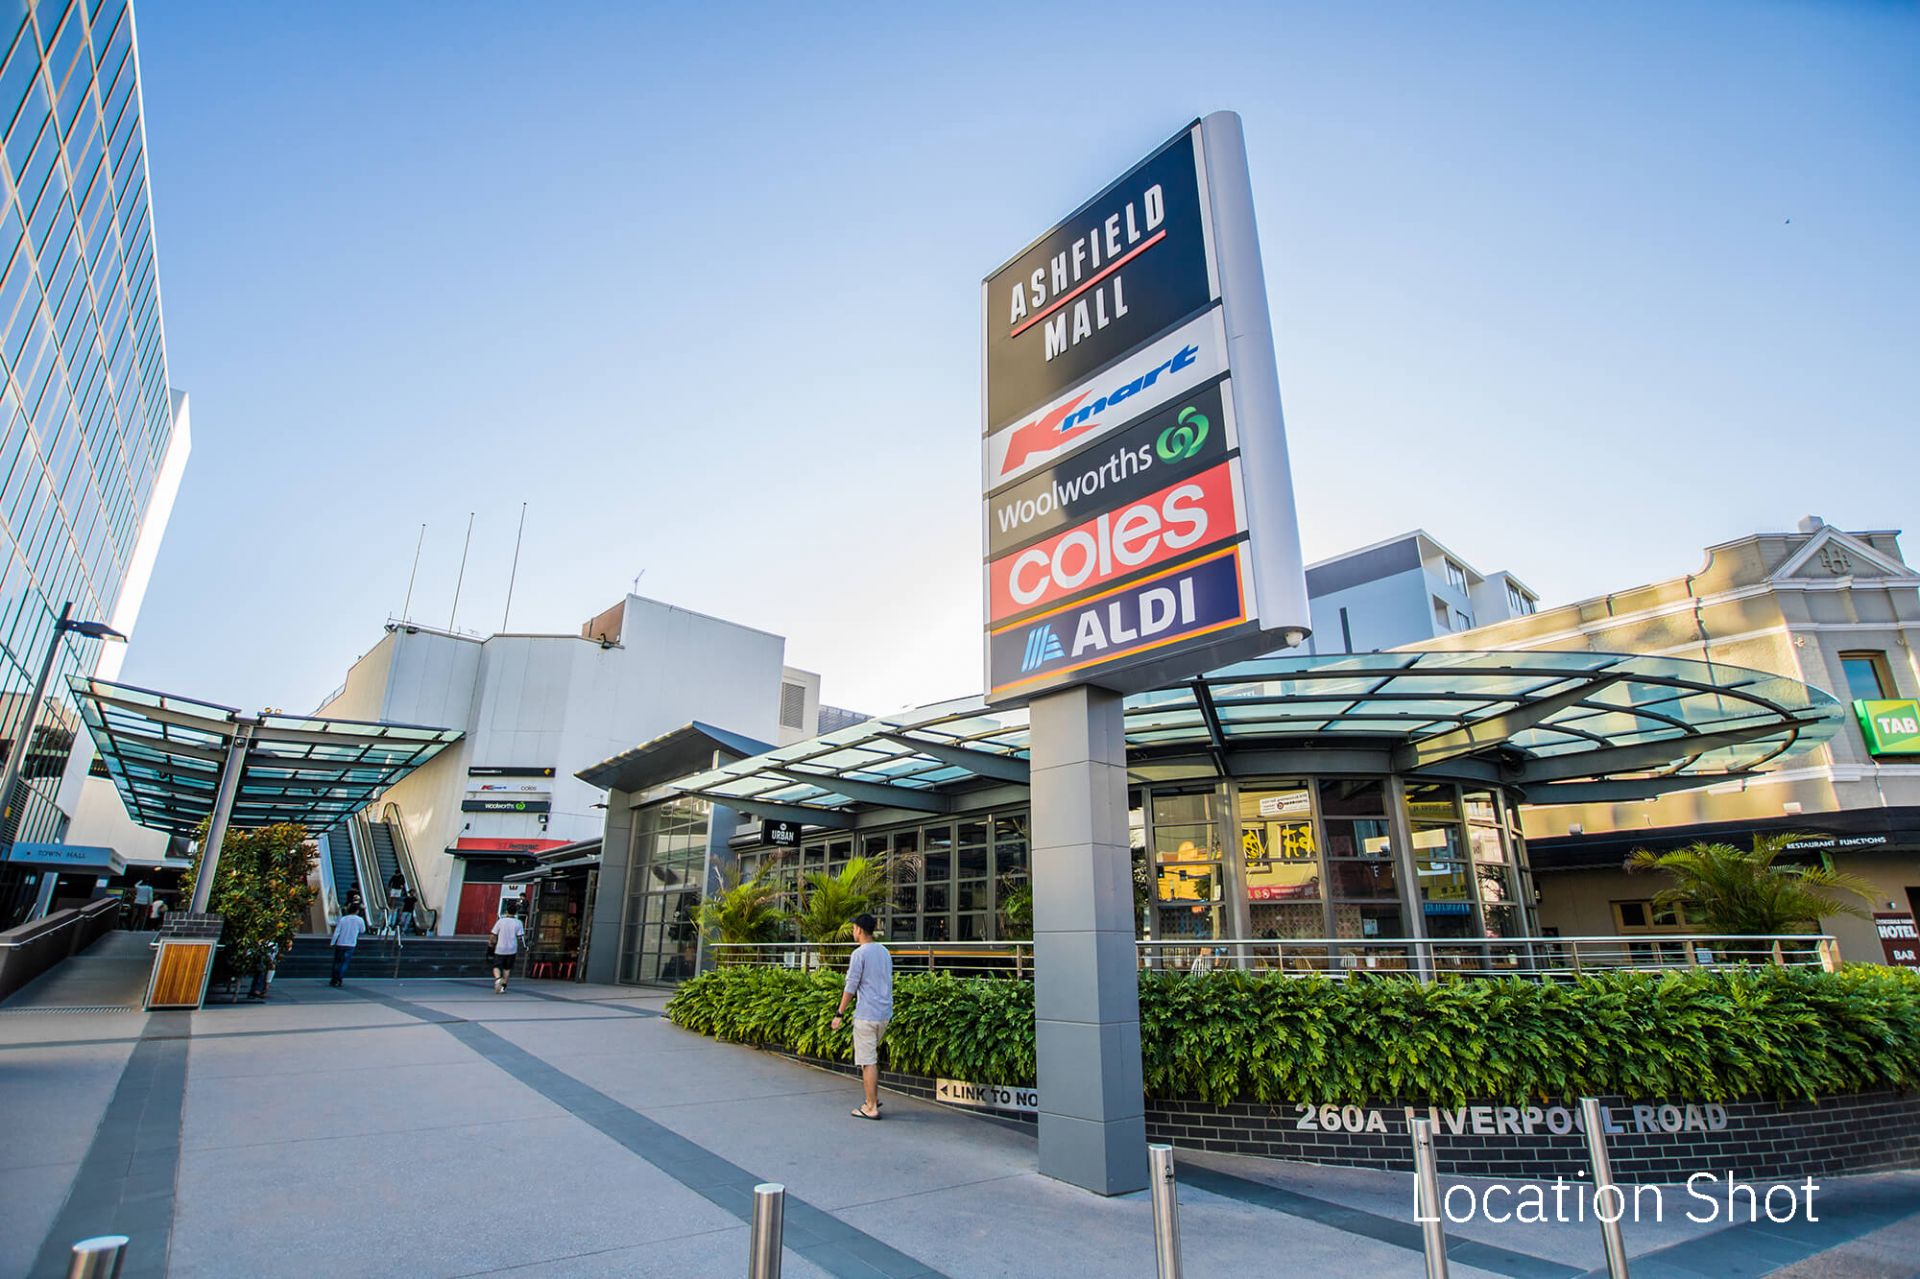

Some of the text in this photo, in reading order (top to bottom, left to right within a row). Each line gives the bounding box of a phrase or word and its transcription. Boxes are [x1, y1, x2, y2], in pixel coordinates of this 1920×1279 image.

[1010, 183, 1165, 325] ASHFIELD
[1044, 275, 1129, 362] MALL
[997, 443, 1153, 533] Woolworths
[1008, 484, 1209, 605] coles
[1071, 577, 1196, 658] ALDI
[1877, 717, 1918, 734] TAB
[771, 829, 795, 842] URBAN
[1786, 840, 1835, 850] RESTAURANT
[38, 850, 86, 859] TOWN HALL
[1877, 925, 1918, 939] HOTEL
[1893, 950, 1917, 960] BAR
[953, 1085, 1038, 1107] LINK TO NO
[1294, 1102, 1729, 1135] 260A IVERPOL ROAD
